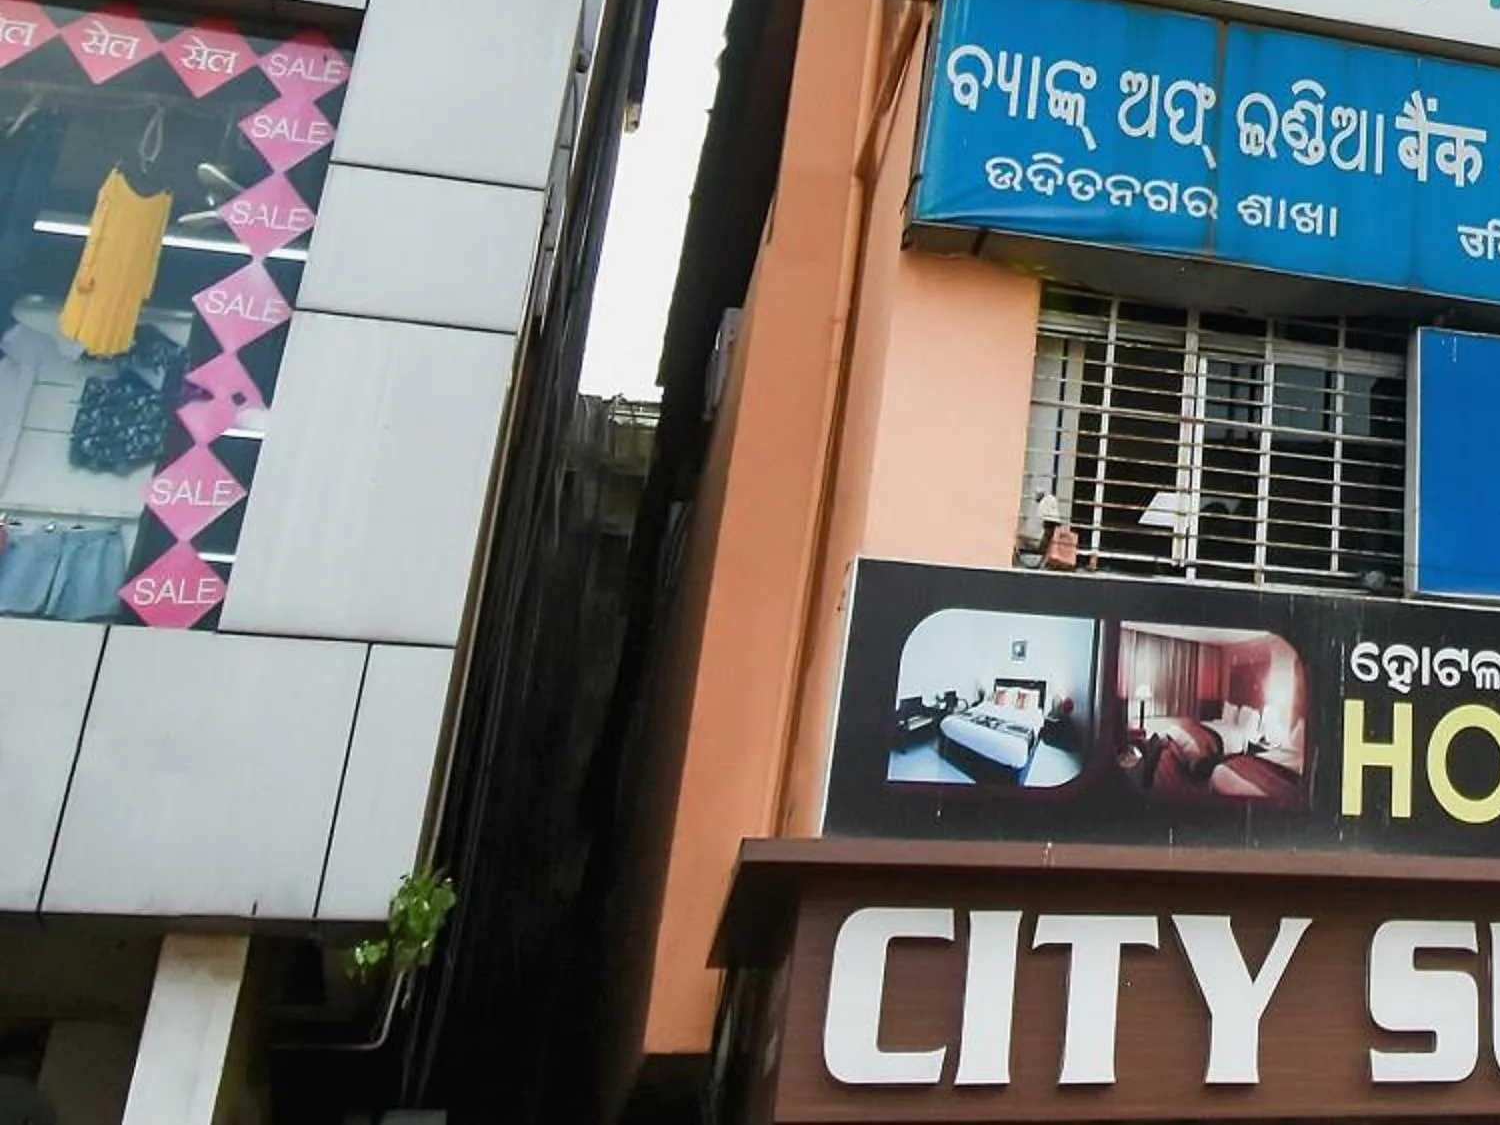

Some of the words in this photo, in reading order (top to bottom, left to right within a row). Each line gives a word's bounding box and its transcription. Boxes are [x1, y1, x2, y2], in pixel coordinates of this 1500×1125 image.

[81, 19, 140, 60] सेल
[180, 35, 240, 75] सेल
[268, 52, 345, 84] SALE
[251, 114, 328, 146] SALE
[1395, 89, 1488, 188] बैंक
[984, 152, 1219, 220] ଉଦିତନଗର
[1236, 192, 1339, 238] ଶାଖା
[228, 199, 310, 231] SALE
[203, 289, 287, 324] SALE
[149, 478, 235, 507] SALE
[132, 578, 218, 605] SALE
[822, 906, 1313, 1085] CITY
